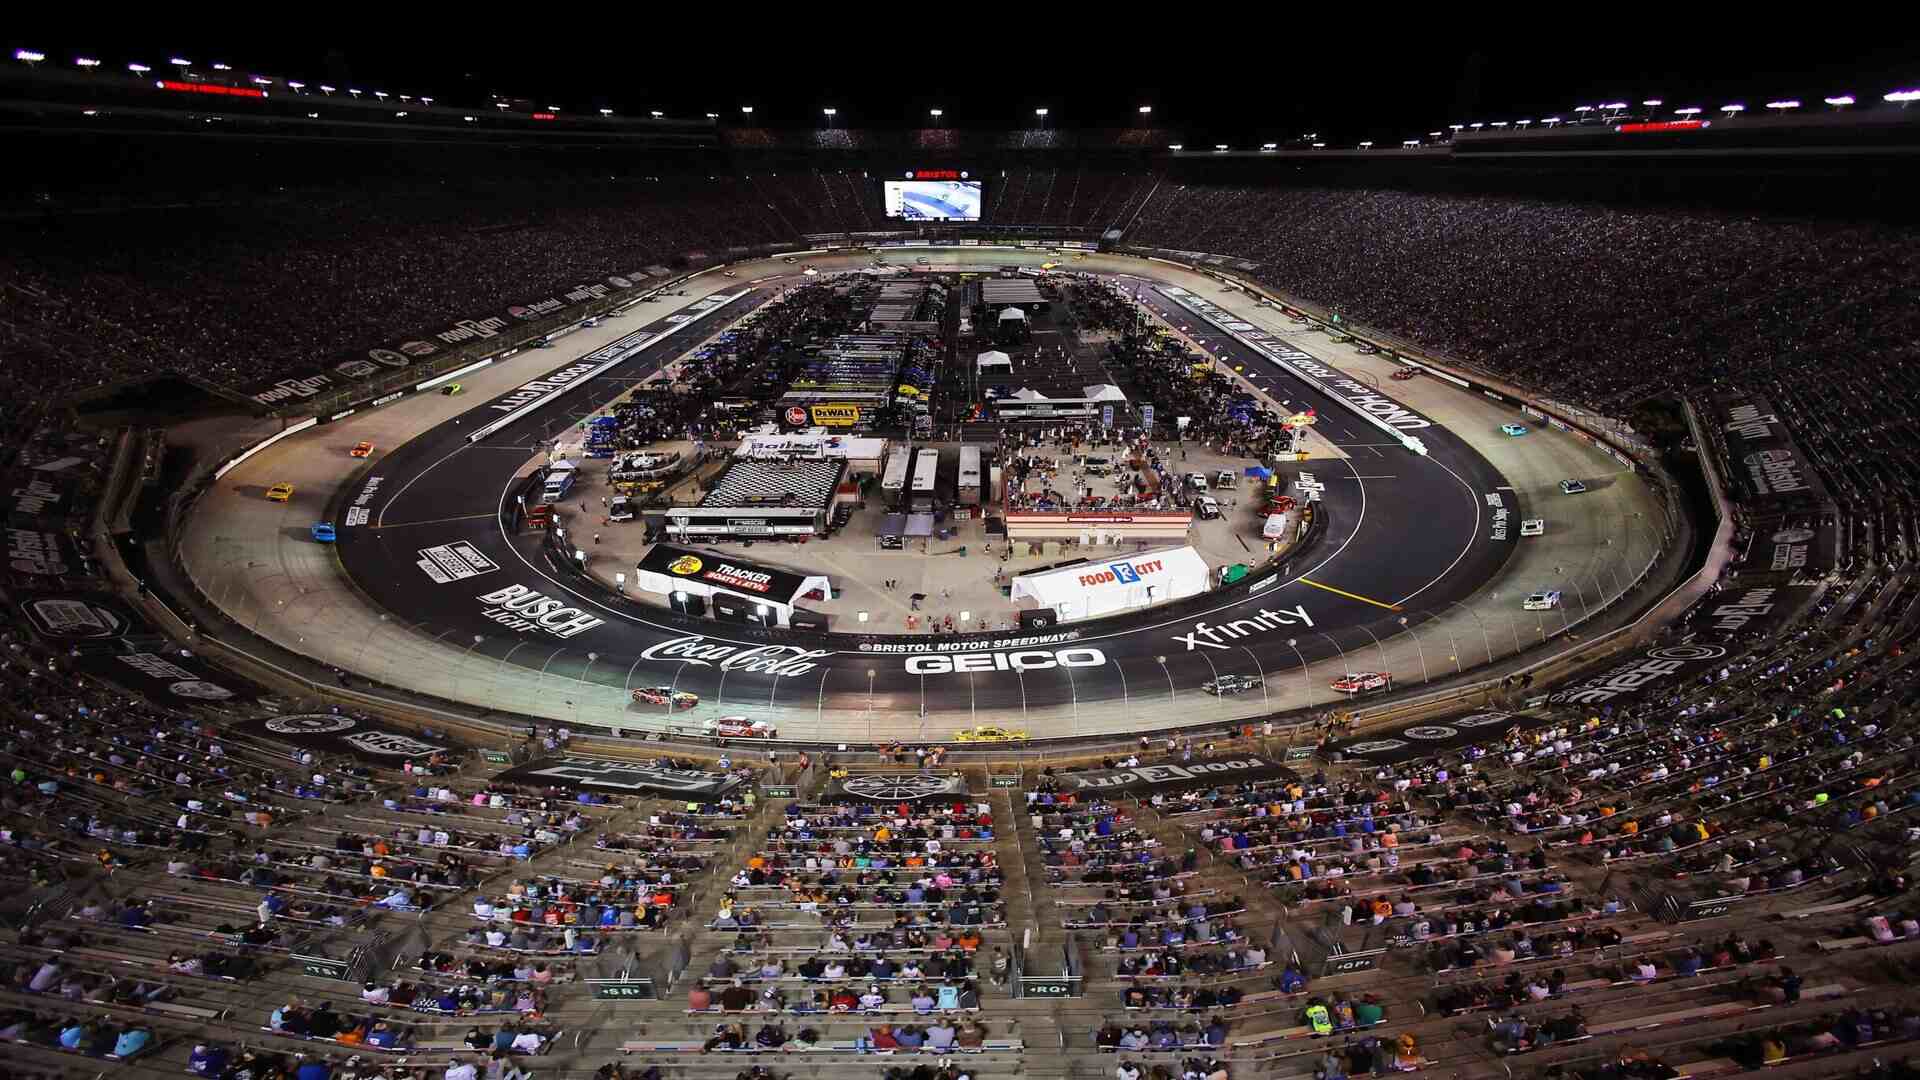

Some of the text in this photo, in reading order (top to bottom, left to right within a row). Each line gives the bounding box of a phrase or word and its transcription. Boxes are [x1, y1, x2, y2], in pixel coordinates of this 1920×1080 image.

[916, 170, 958, 178] BRISTOL
[490, 391, 542, 412] CITY
[716, 563, 772, 584] TRACKER
[1078, 560, 1164, 587] FOOD CITY
[475, 583, 607, 639] BUSCH
[1171, 605, 1315, 651] xfinity
[872, 632, 1069, 653] BRISTOL MOTOR SPEEDWAY
[904, 648, 1107, 675] GEICO
[1077, 757, 1266, 788] FOOD CITY
